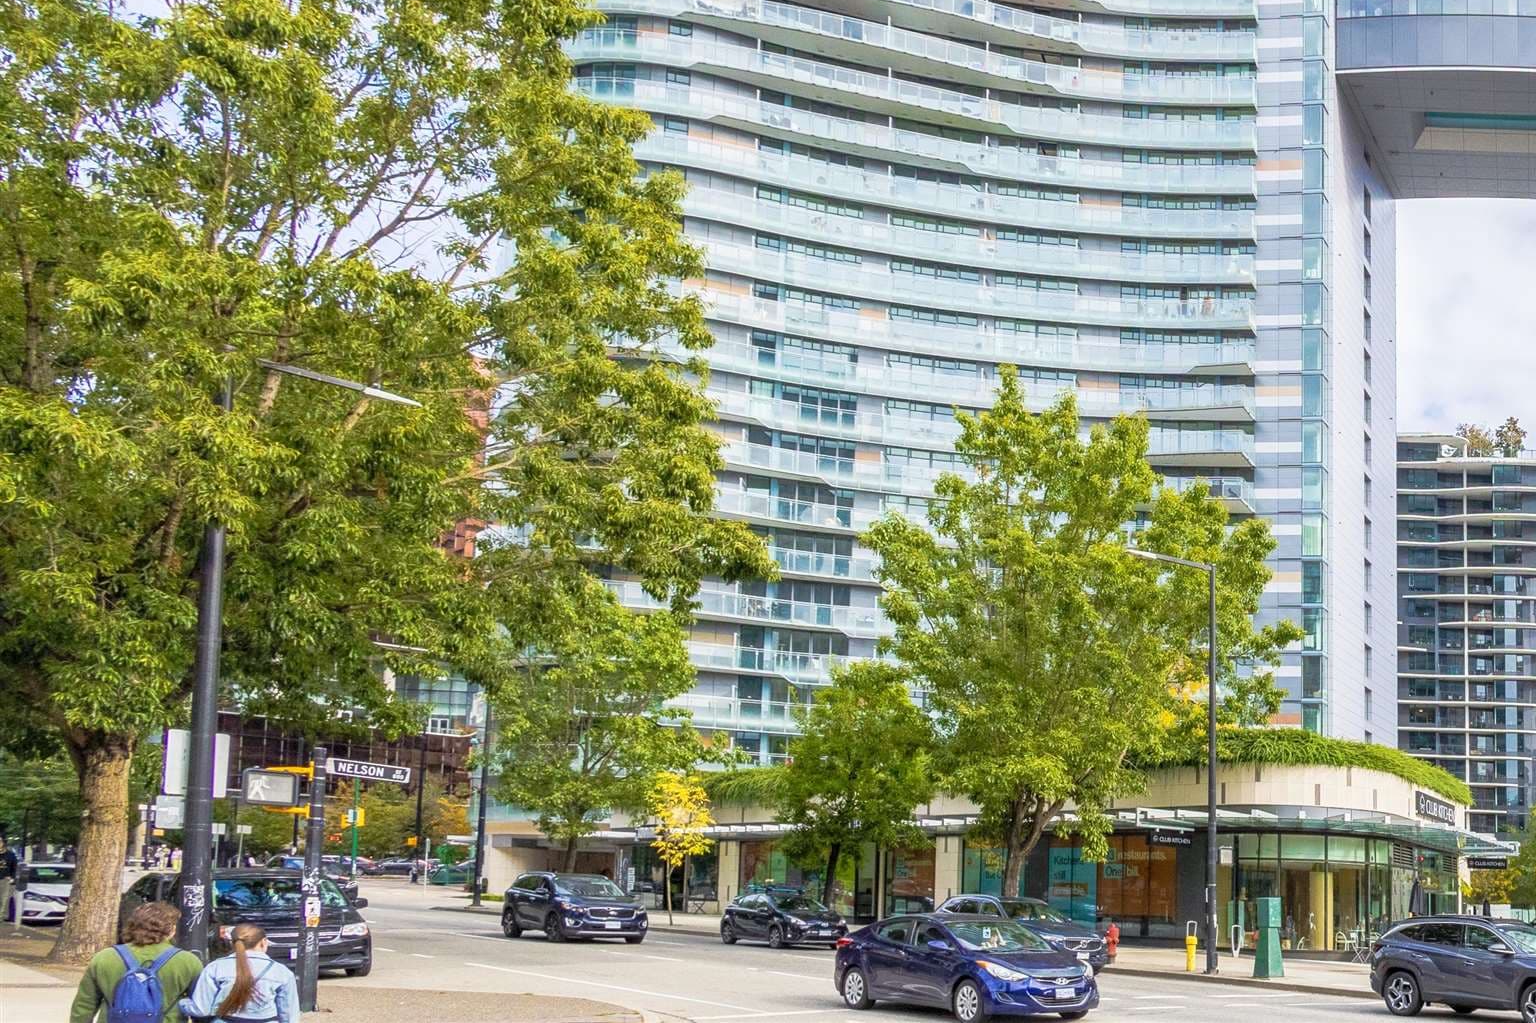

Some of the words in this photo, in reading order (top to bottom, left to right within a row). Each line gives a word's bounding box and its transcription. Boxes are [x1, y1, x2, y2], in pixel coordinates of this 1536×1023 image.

[338, 762, 384, 777] NELSON
[1426, 800, 1437, 816] CLUB
[1438, 805, 1456, 822] KITCHEN
